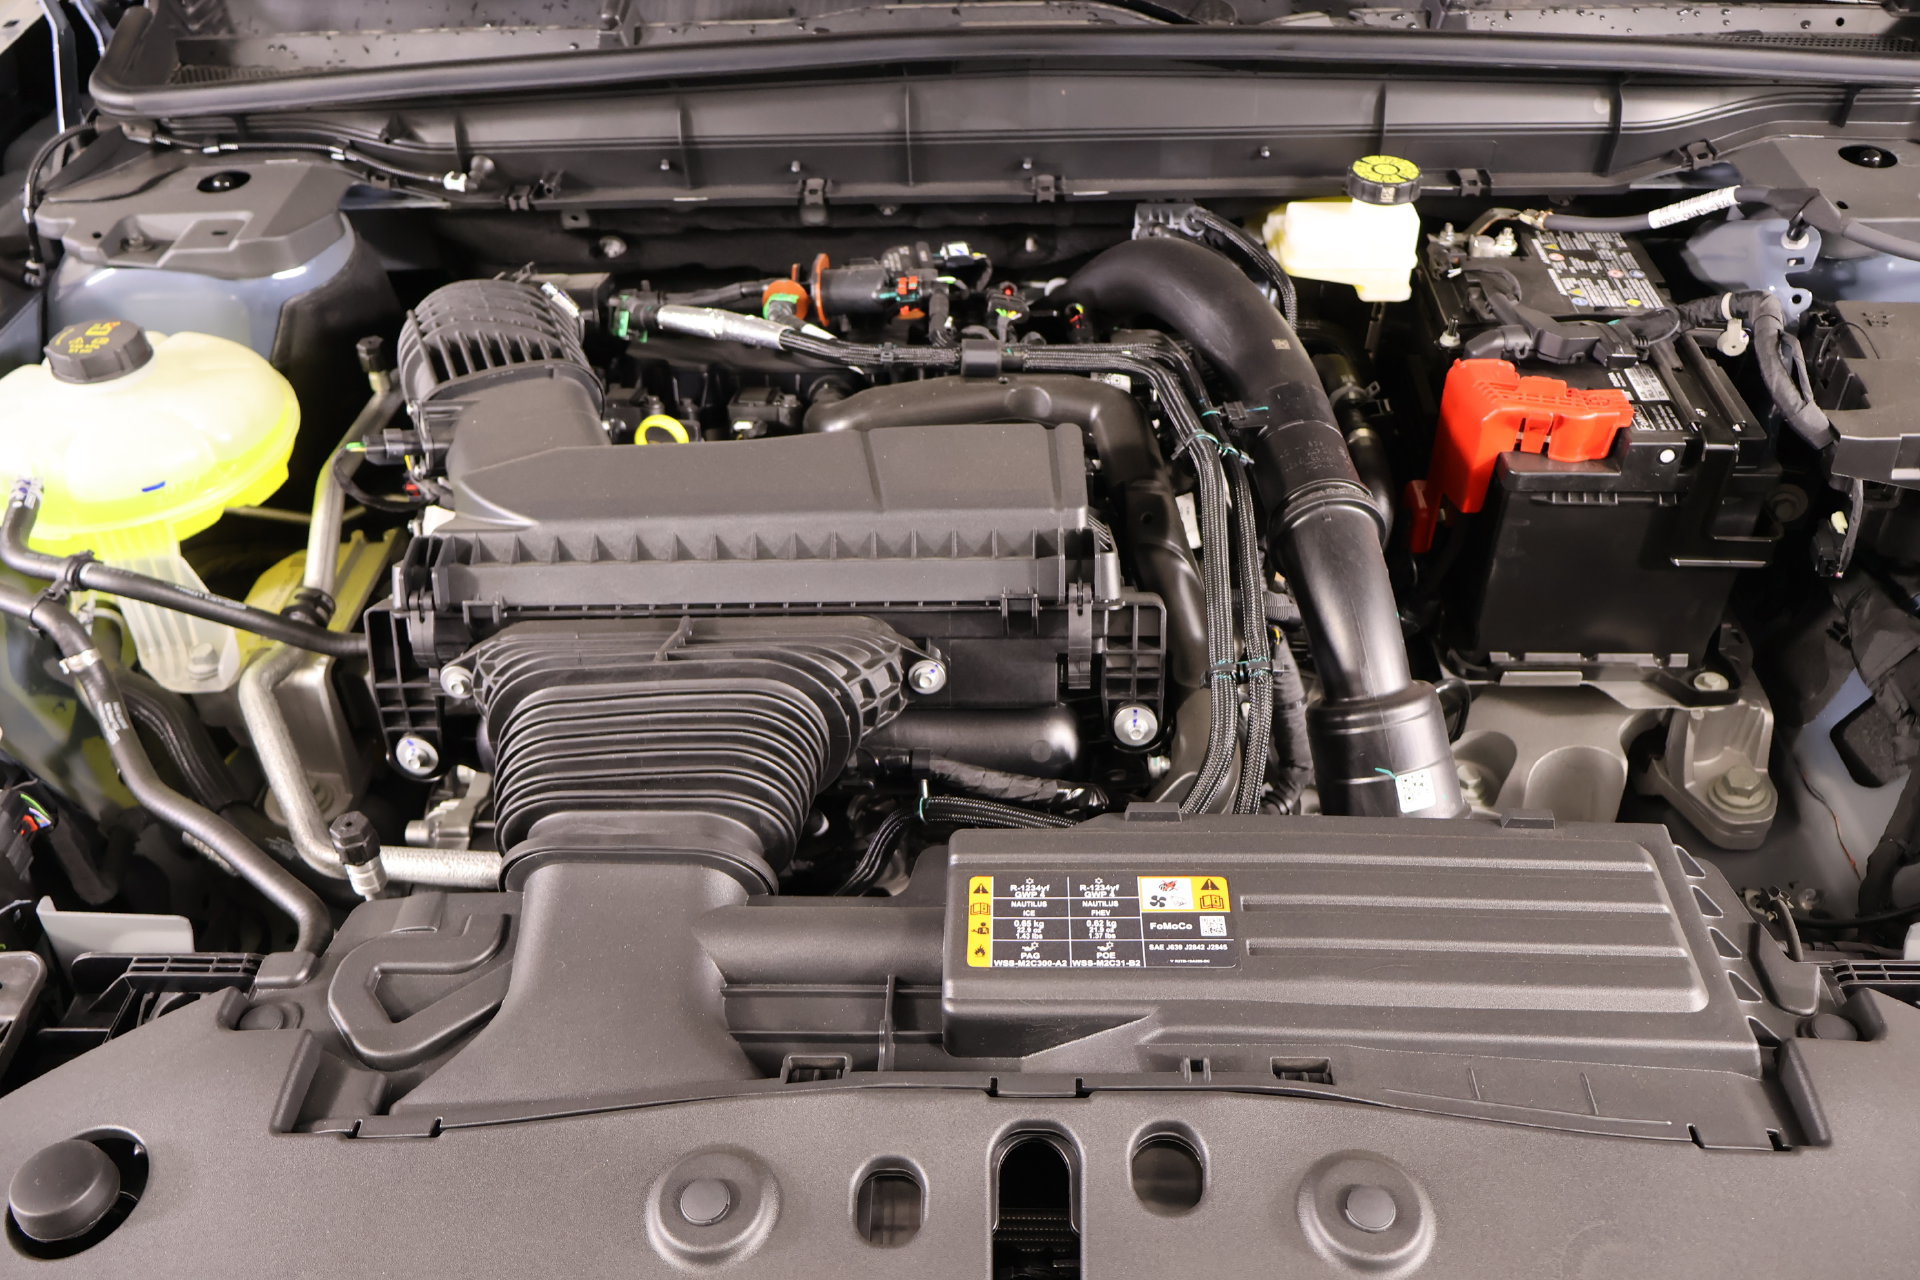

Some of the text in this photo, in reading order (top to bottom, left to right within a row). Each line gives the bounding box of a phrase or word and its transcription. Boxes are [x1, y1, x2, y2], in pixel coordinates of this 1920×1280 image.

[1010, 884, 1050, 892] R-1234yf
[1079, 884, 1120, 892] R-1234yf
[1091, 909, 1111, 917] FHEV
[1013, 920, 1045, 929] 0.65 kg
[1086, 919, 1117, 929] 0.62 kg
[1149, 922, 1193, 930] FoMoCo
[1072, 959, 1141, 967] WSS-M2C31-B2
